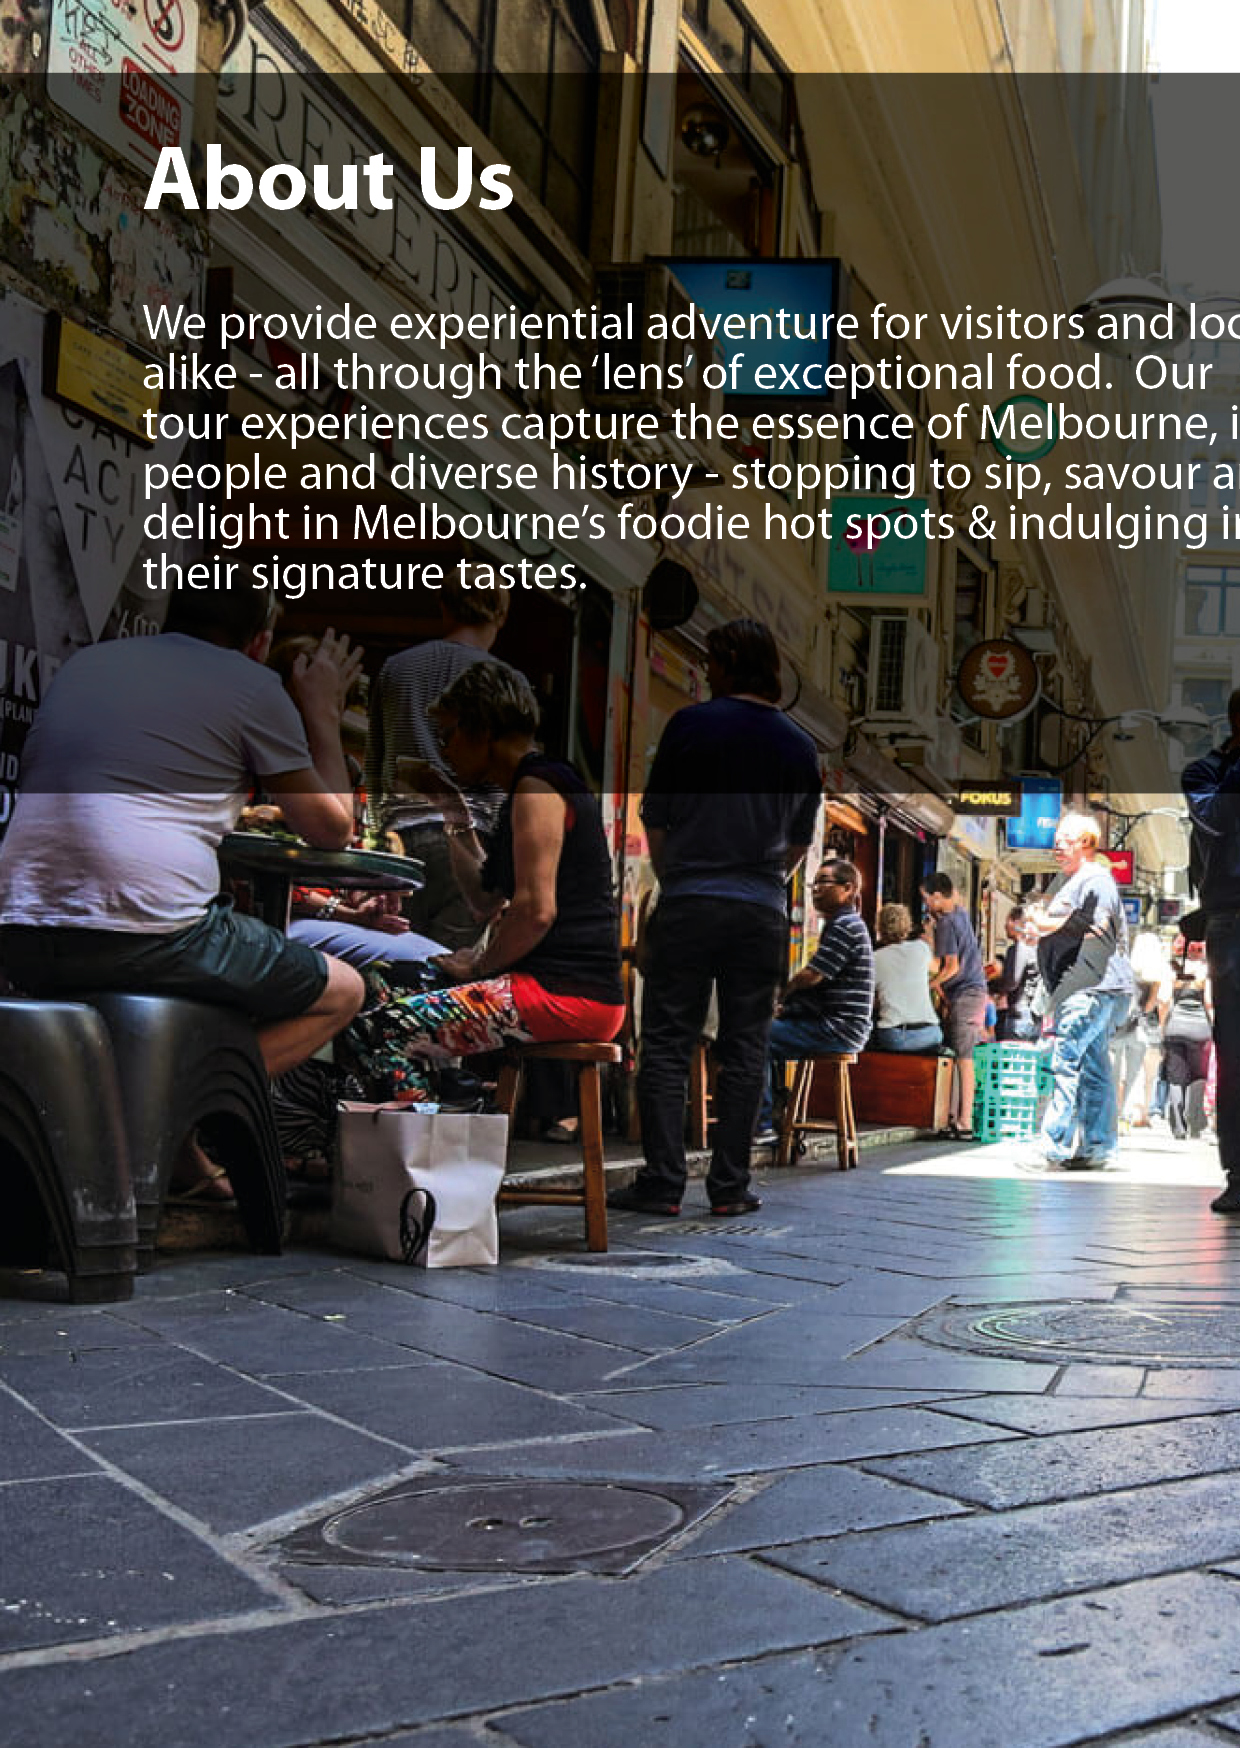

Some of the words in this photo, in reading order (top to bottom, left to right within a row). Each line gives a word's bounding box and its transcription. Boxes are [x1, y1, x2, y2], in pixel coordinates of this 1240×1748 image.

[122, 62, 180, 130] LOADING
[126, 93, 177, 147] ZONE
[960, 791, 1012, 806] FOKUS
